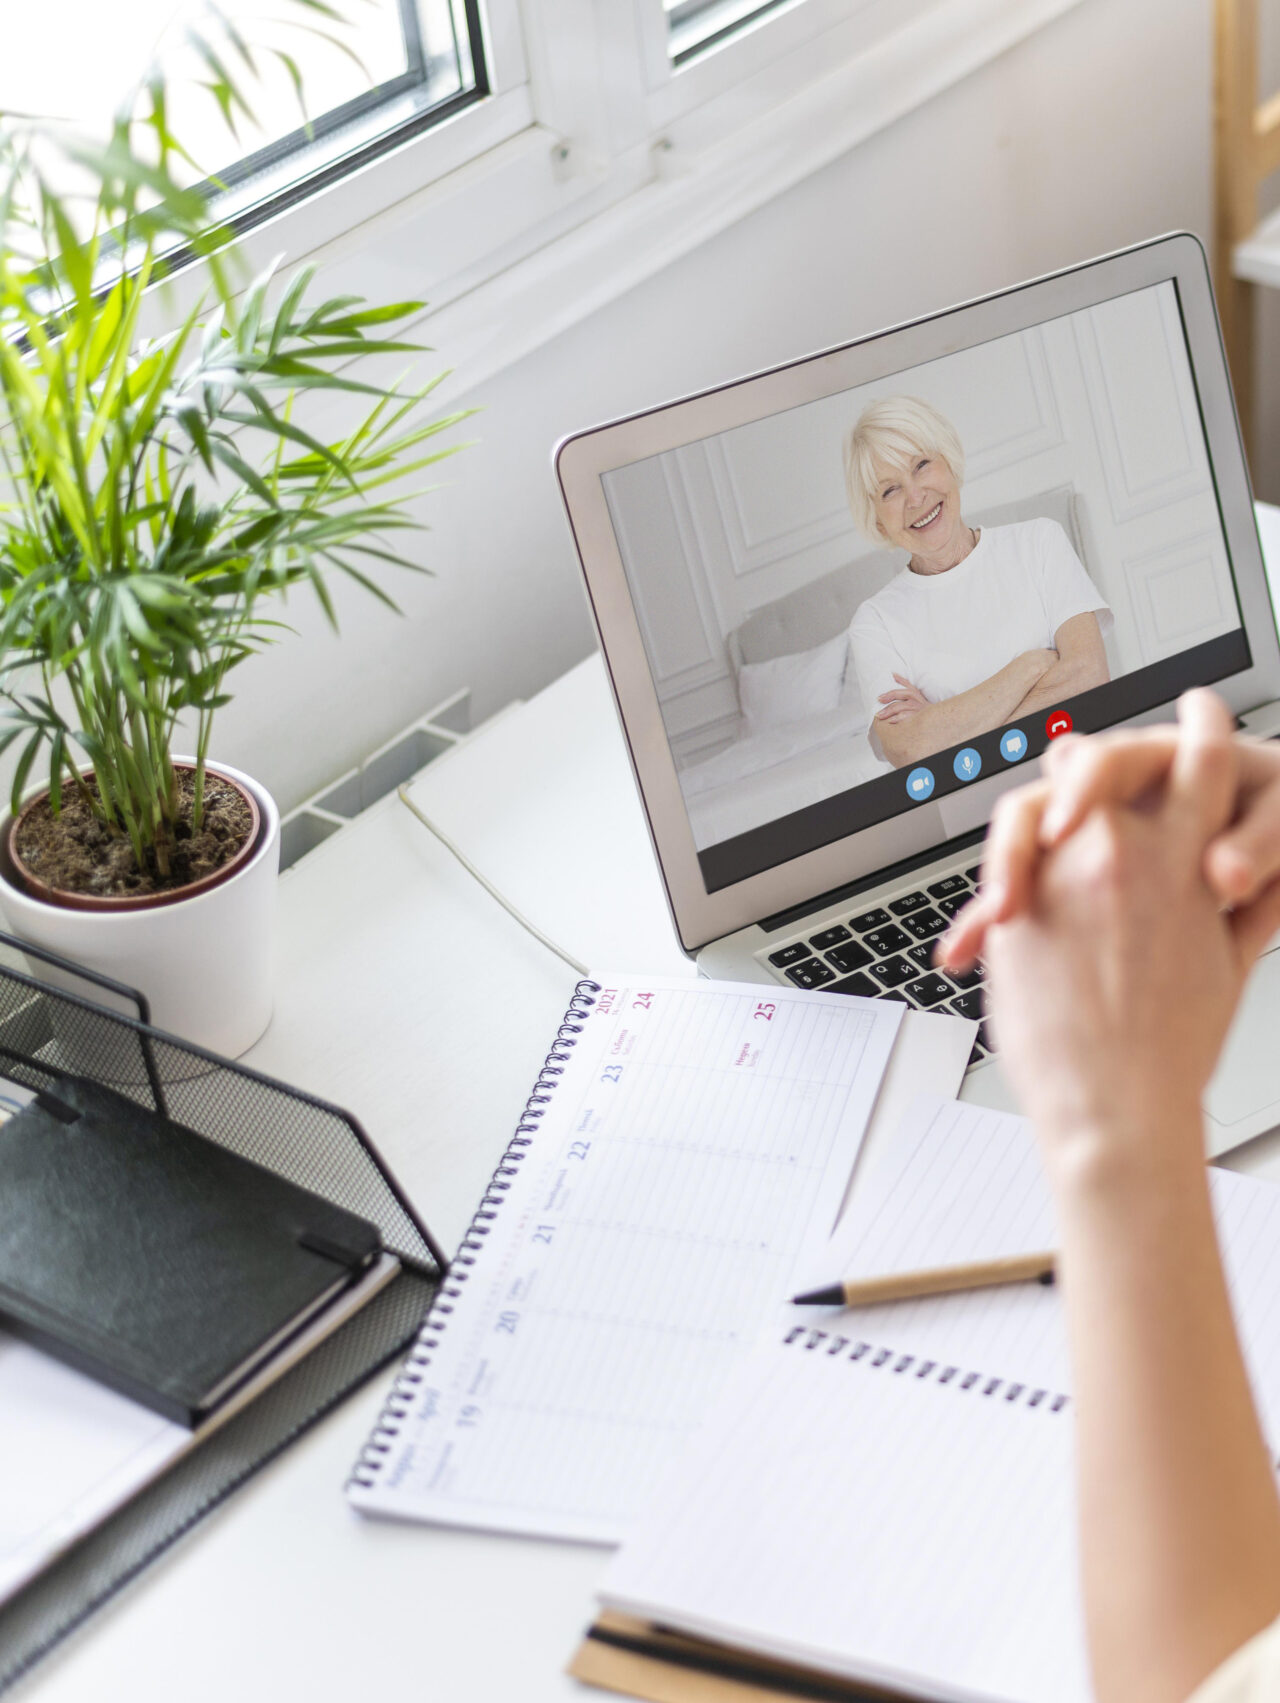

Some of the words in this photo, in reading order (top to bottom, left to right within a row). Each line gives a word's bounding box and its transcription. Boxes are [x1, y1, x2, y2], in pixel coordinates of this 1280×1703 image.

[916, 926, 925, 934] 3
[878, 942, 889, 950] 2
[913, 947, 927, 957] W
[875, 965, 889, 974] Q
[899, 964, 914, 974] Й
[936, 984, 948, 992] Ф
[595, 988, 619, 1015] 2021
[632, 991, 656, 1010] 24
[956, 998, 970, 1008] Z
[752, 1002, 777, 1021] 25
[600, 1064, 624, 1083] 23
[567, 1140, 592, 1161] 22
[531, 1224, 557, 1245] 21
[494, 1310, 521, 1335] 20
[455, 1404, 482, 1428] 19
